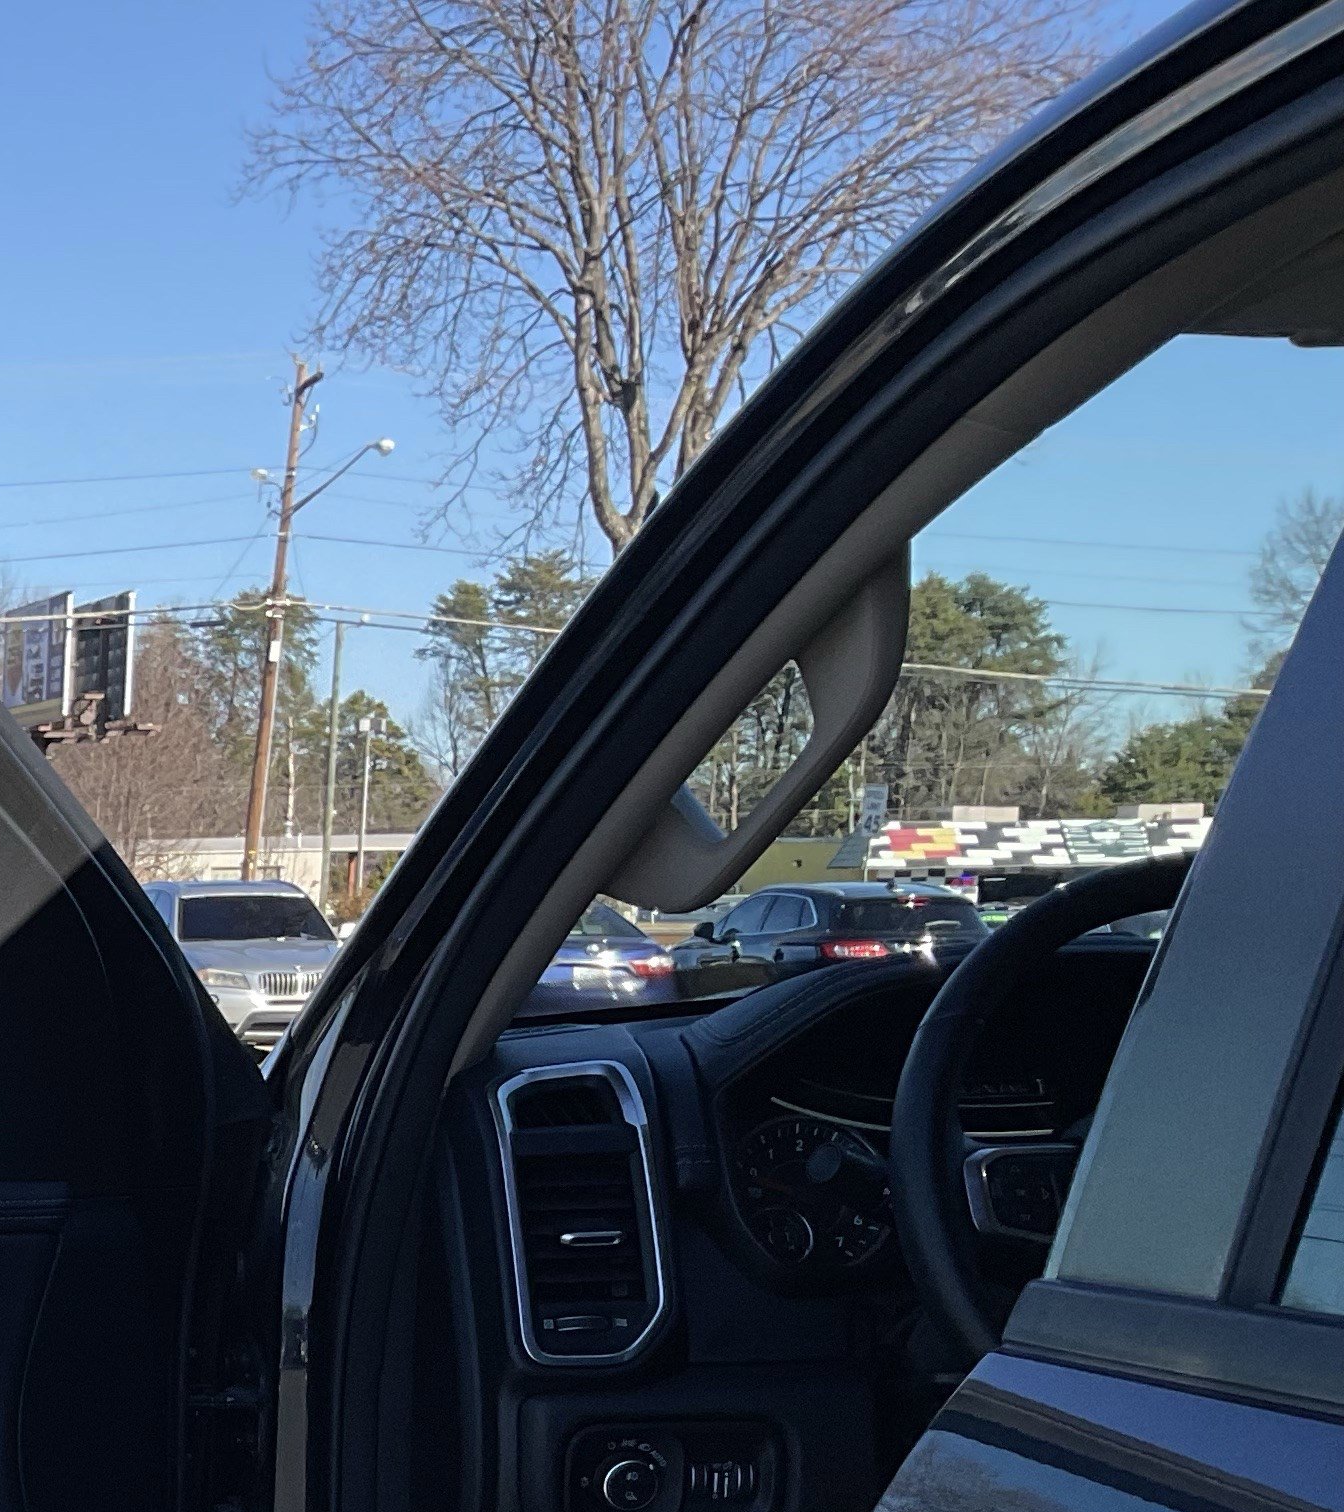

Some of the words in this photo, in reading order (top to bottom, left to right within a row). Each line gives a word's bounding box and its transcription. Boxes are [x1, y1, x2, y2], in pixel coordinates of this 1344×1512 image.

[864, 814, 880, 833] 45
[795, 1140, 804, 1152] 2
[853, 1215, 863, 1226] 6
[835, 1236, 844, 1247] 7
